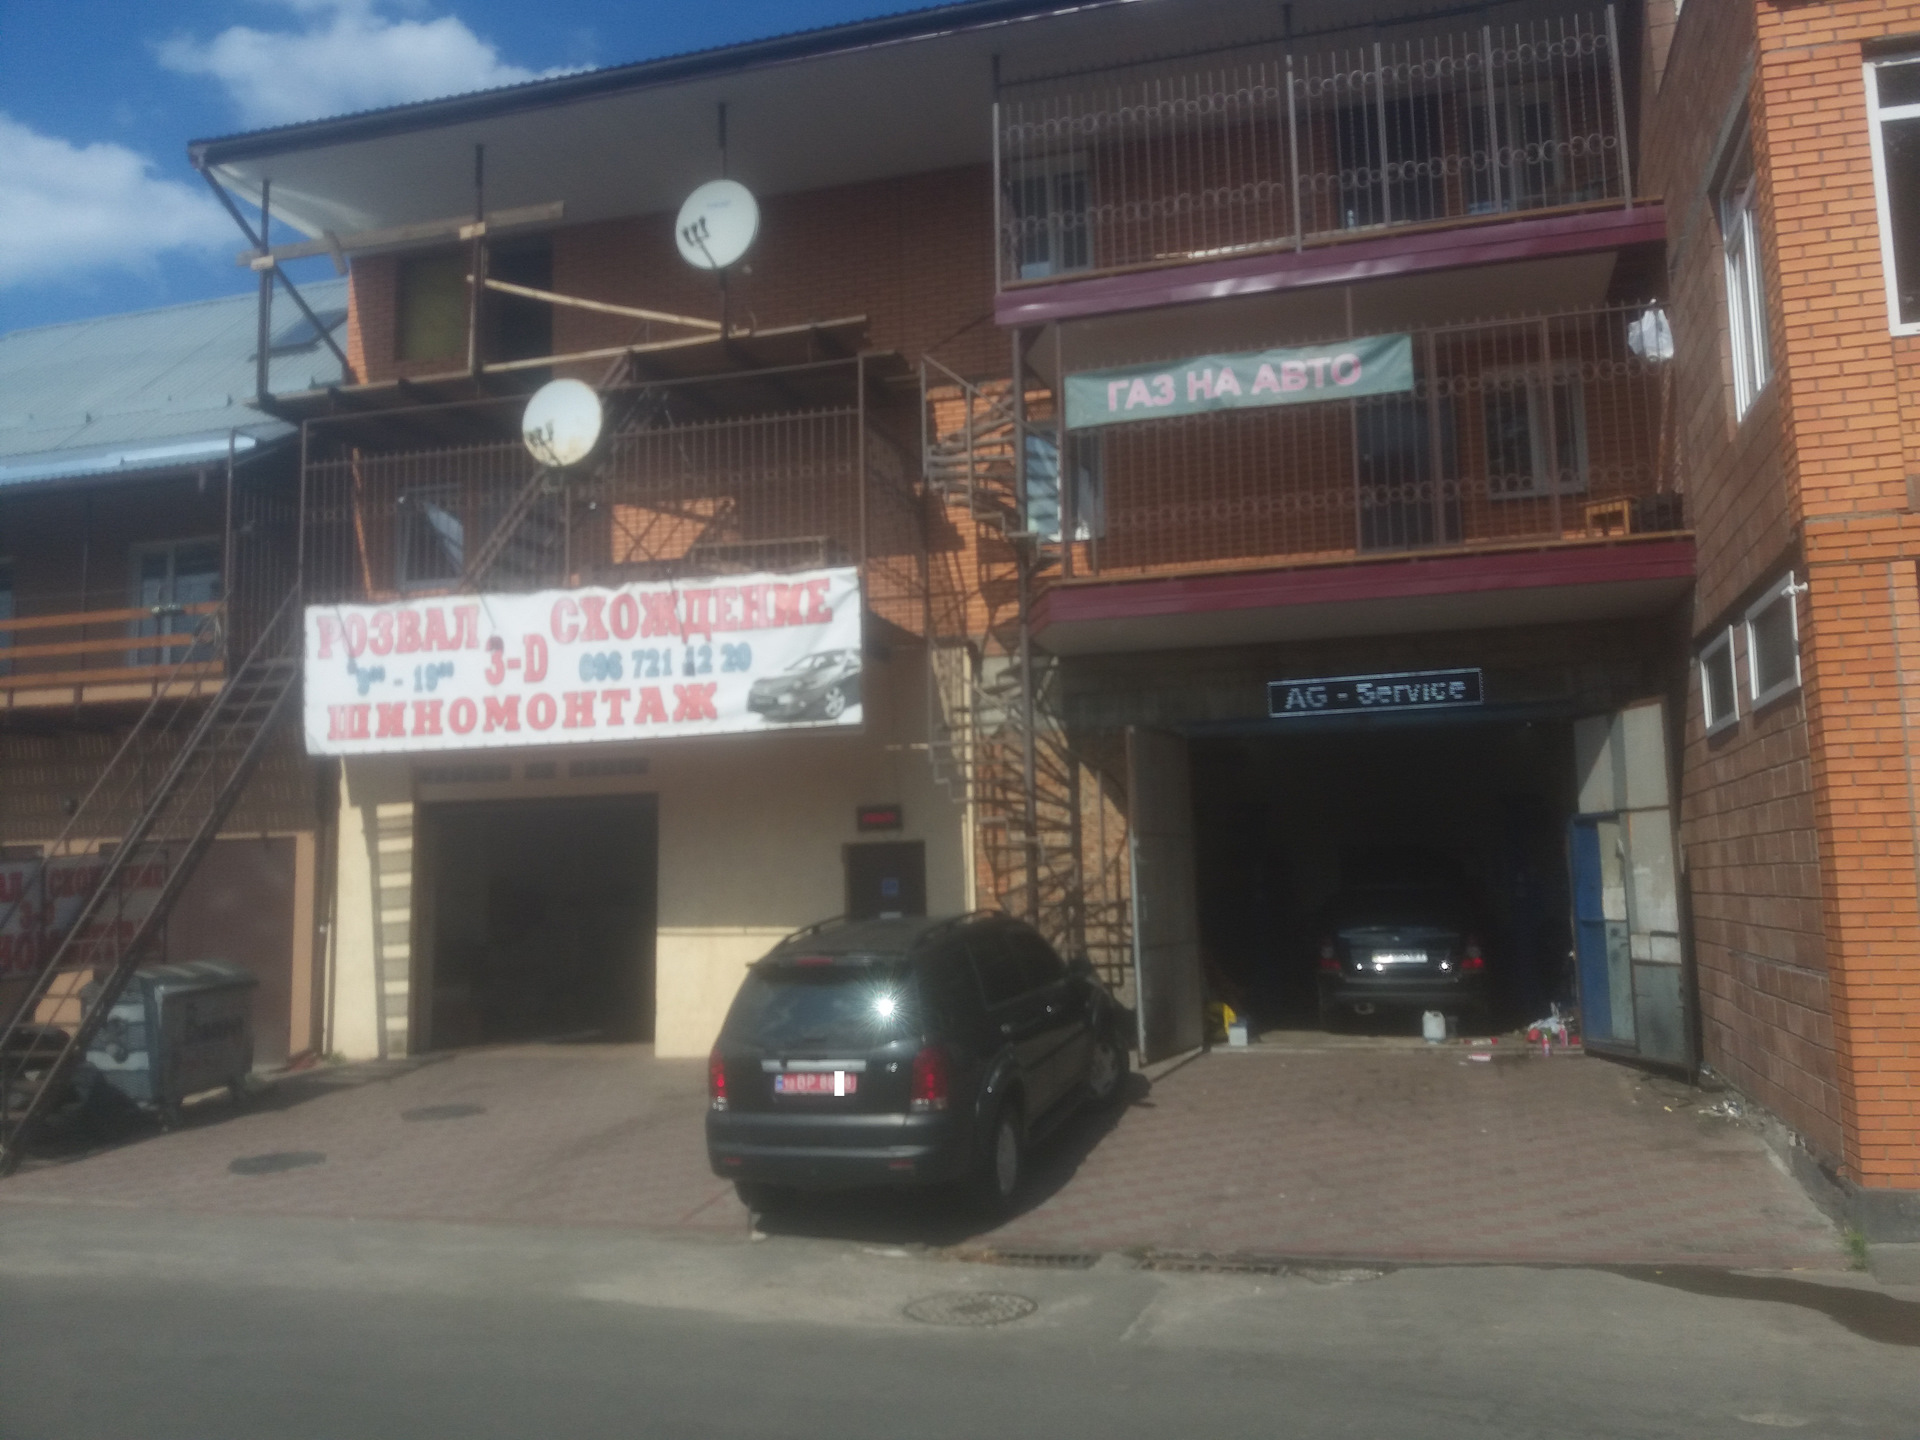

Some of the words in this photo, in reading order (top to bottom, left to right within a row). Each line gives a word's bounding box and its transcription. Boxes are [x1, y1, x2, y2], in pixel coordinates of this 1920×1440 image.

[1107, 374, 1175, 411] ГАЗ
[1187, 368, 1241, 401] НА
[1251, 353, 1362, 395] АВТО
[316, 604, 480, 659] РОЗВАЛ
[550, 577, 833, 645] СХОЖДЕНИЕ
[631, 647, 673, 679] 721
[327, 682, 717, 741] ШИНОМОНТАЖ
[1285, 685, 1328, 709] AG
[1355, 681, 1467, 705] Service
